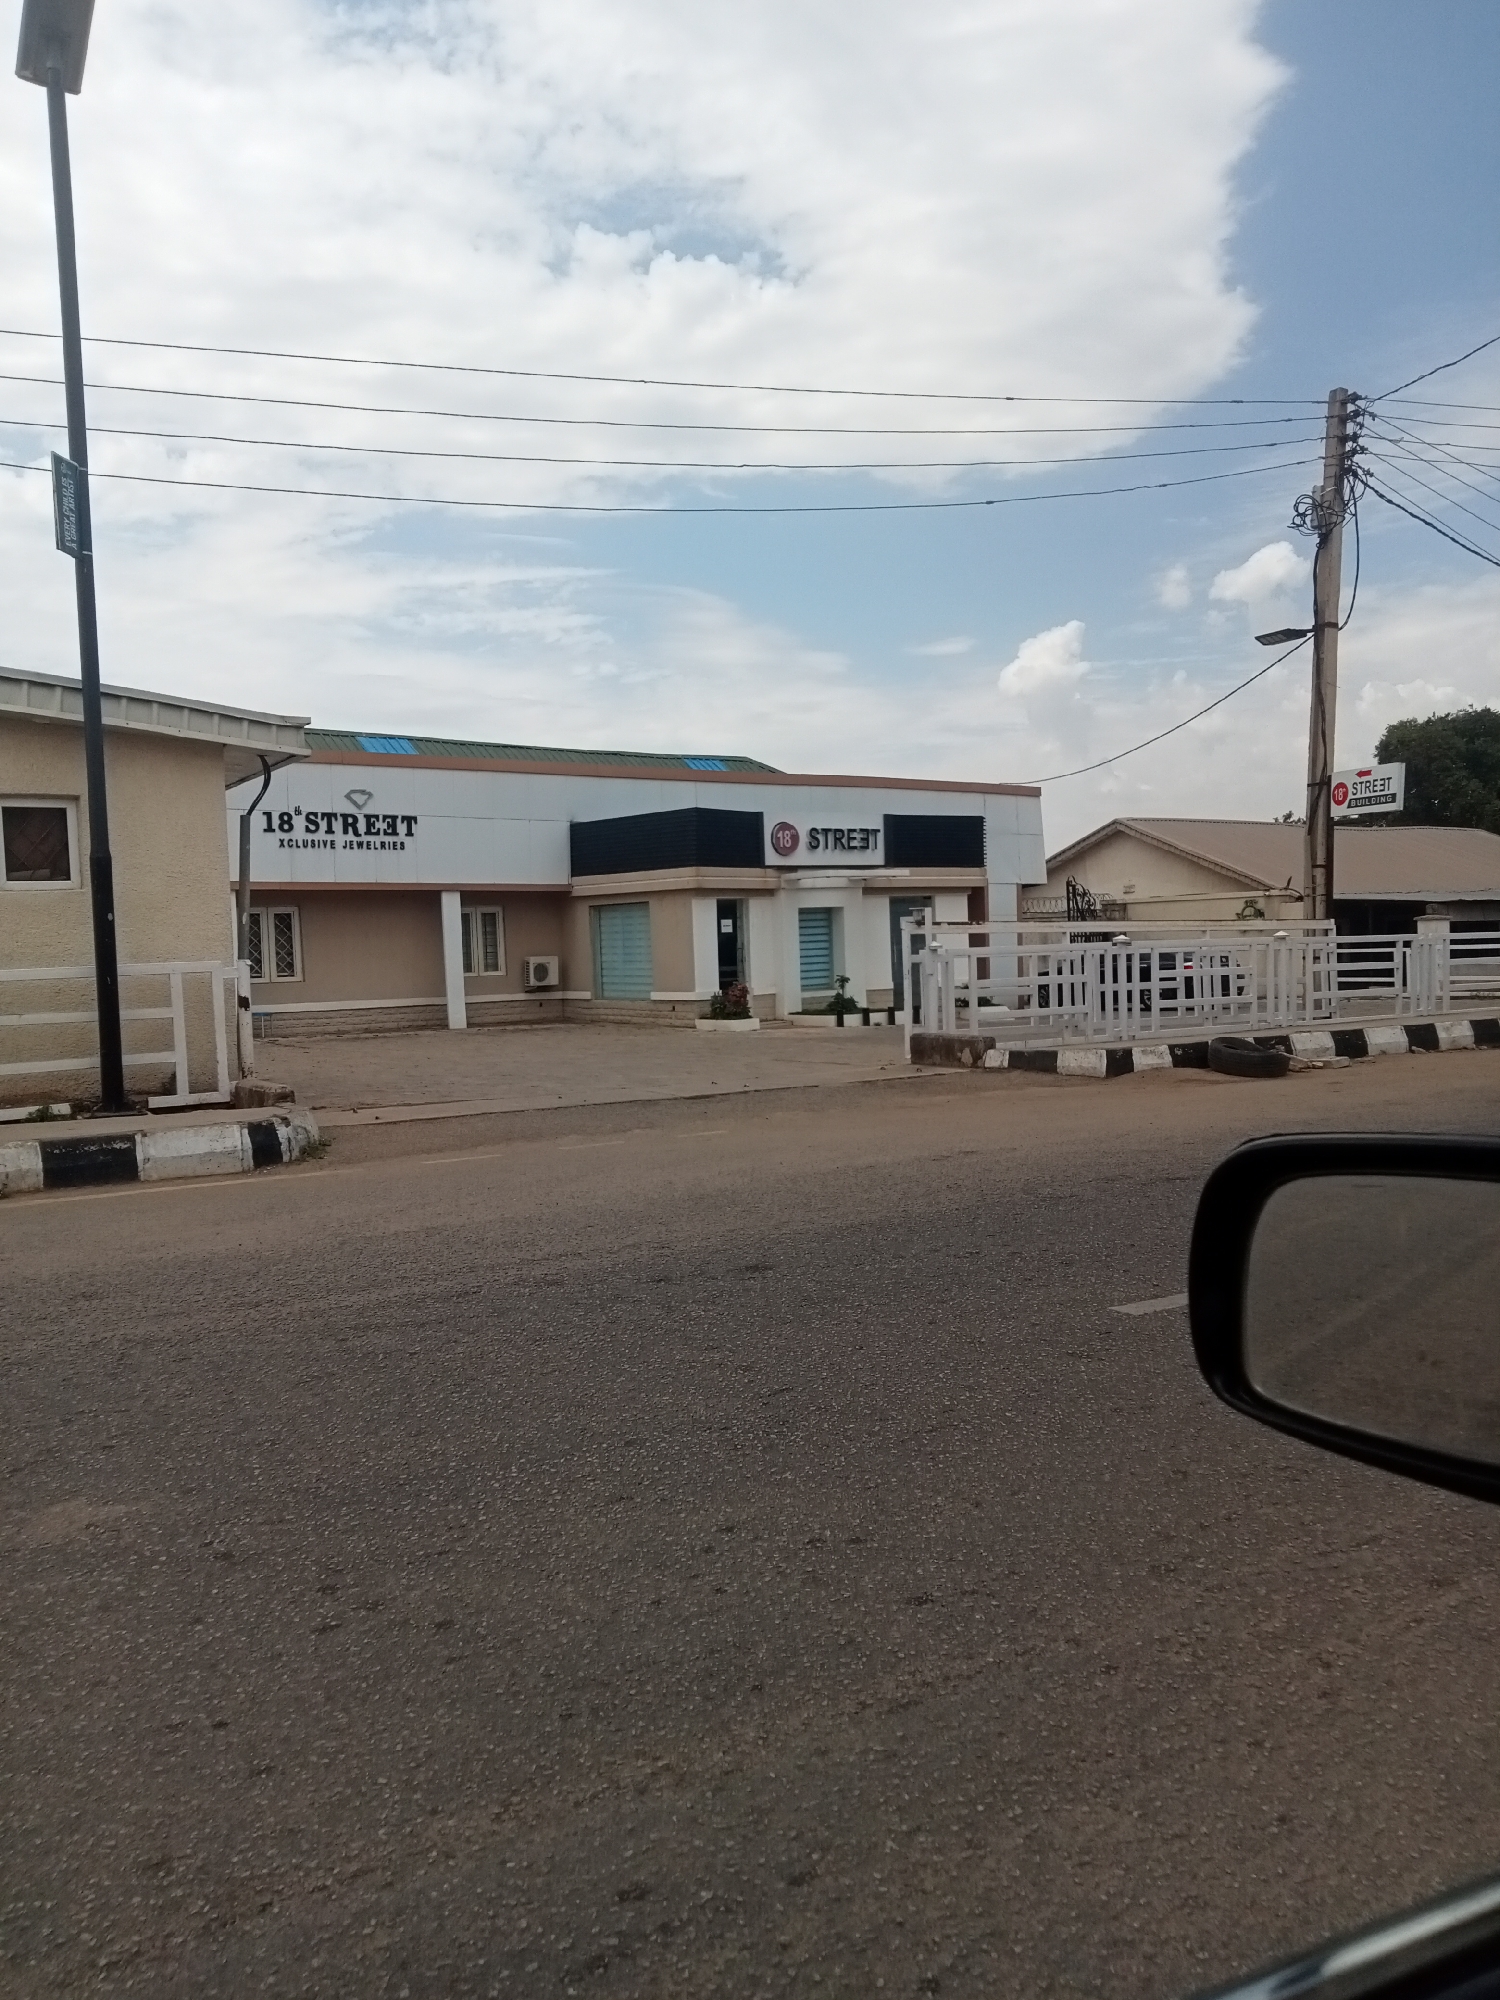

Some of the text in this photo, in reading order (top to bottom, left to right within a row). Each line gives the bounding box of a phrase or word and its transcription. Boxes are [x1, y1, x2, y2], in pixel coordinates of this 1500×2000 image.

[67, 478, 75, 510] ARTIST
[61, 476, 72, 547] EVERY CHILD IS
[69, 513, 77, 541] GREAT
[1351, 795, 1392, 806] BUILDING
[278, 838, 406, 851] XCLUSIVE JEWELRIES
